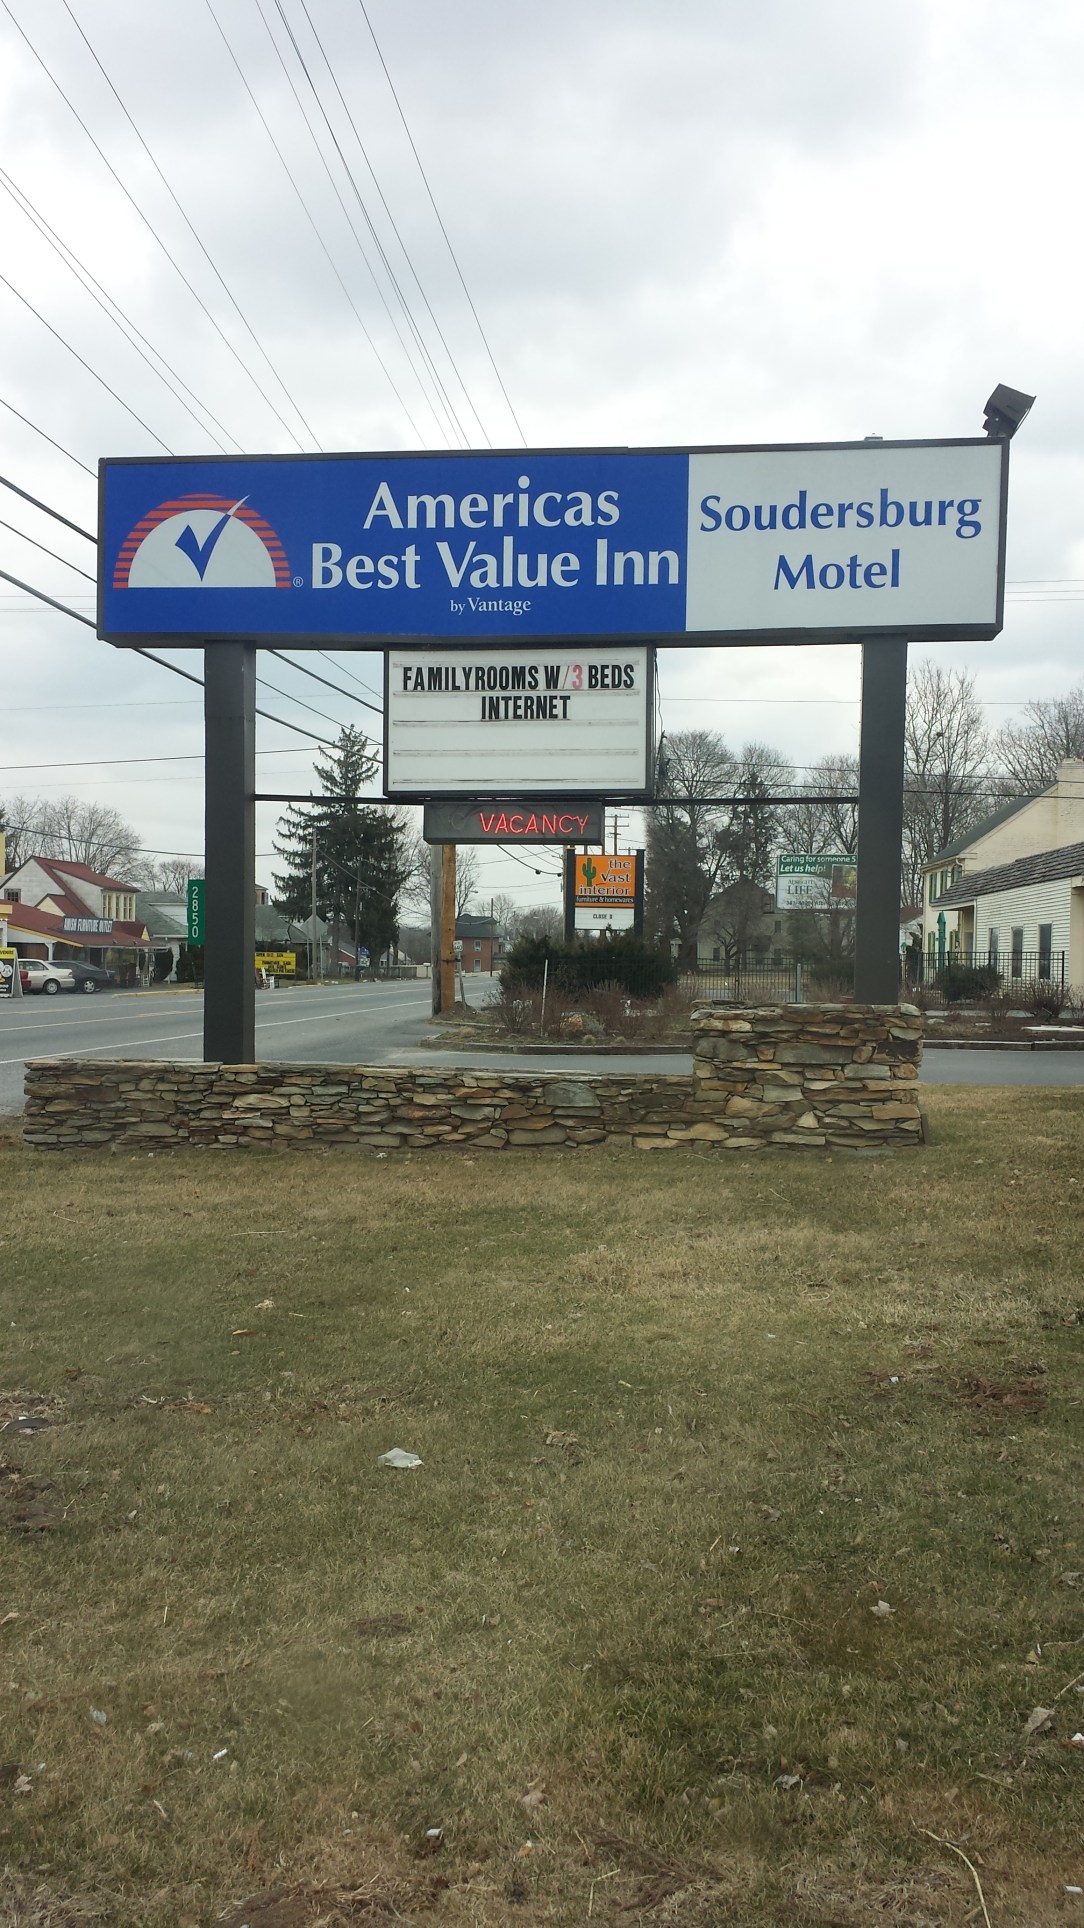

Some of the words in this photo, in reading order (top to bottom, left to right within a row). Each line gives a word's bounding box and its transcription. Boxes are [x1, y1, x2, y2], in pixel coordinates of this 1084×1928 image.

[363, 475, 620, 529] Americas
[700, 488, 982, 539] Soudersburg
[311, 542, 421, 589] Best
[436, 535, 579, 589] Value
[596, 538, 679, 586] Inn
[774, 549, 900, 590] Motel
[450, 600, 465, 615] by
[467, 597, 531, 616] Vantage
[588, 664, 635, 689] BEDS
[481, 696, 570, 720] INTERNET
[479, 812, 589, 835] VACANCY
[609, 859, 631, 869] the
[780, 864, 793, 872] Let
[781, 855, 804, 863] Caring
[579, 885, 630, 895] interior
